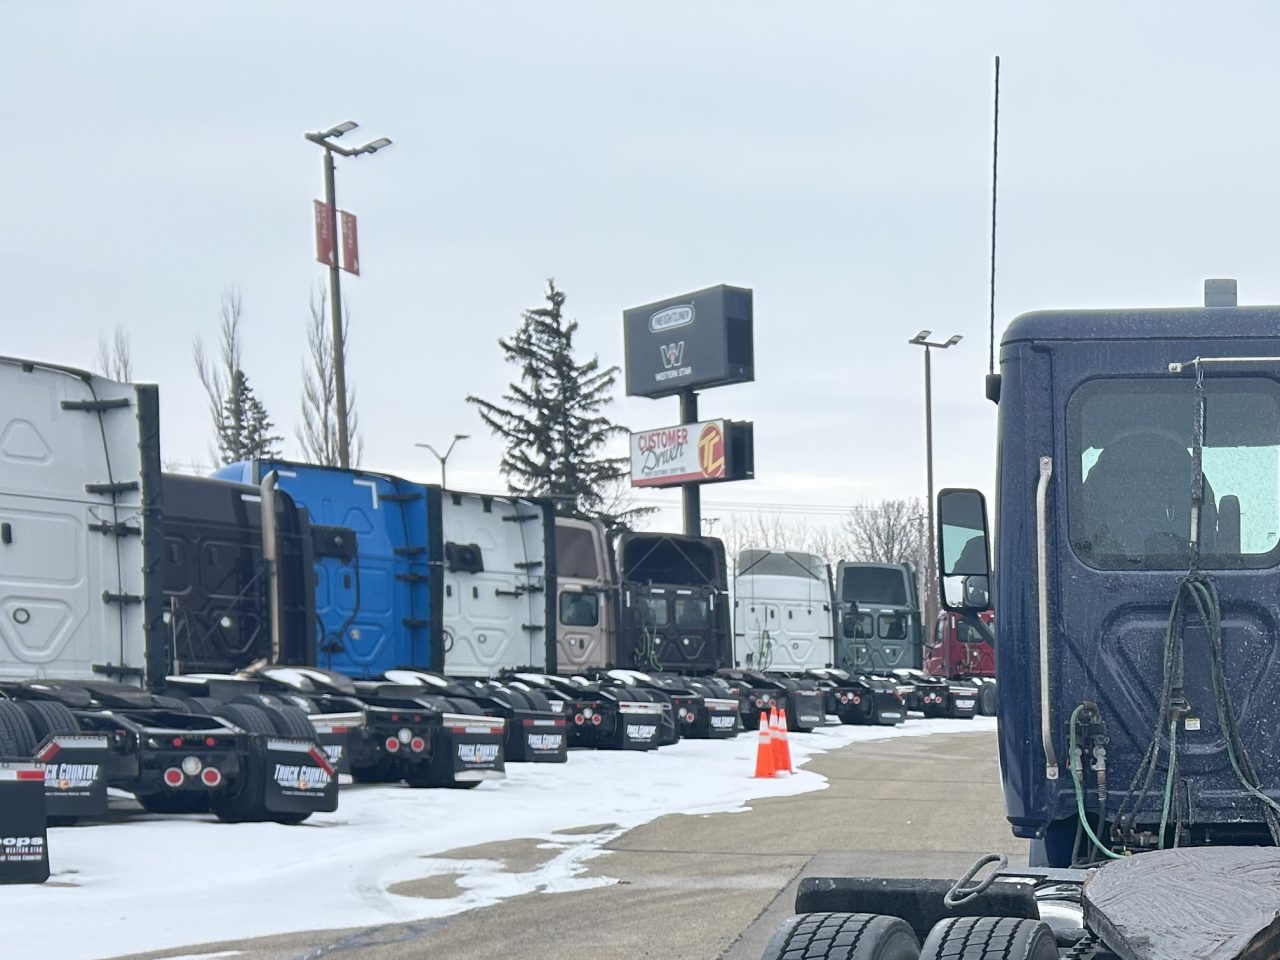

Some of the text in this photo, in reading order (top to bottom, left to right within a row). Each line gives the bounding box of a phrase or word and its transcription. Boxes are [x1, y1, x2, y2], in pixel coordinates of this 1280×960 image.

[638, 429, 688, 451] CUSTOMER
[59, 763, 99, 780] COUNTRY
[274, 764, 300, 780] TRUCK
[0, 837, 43, 846] ops
